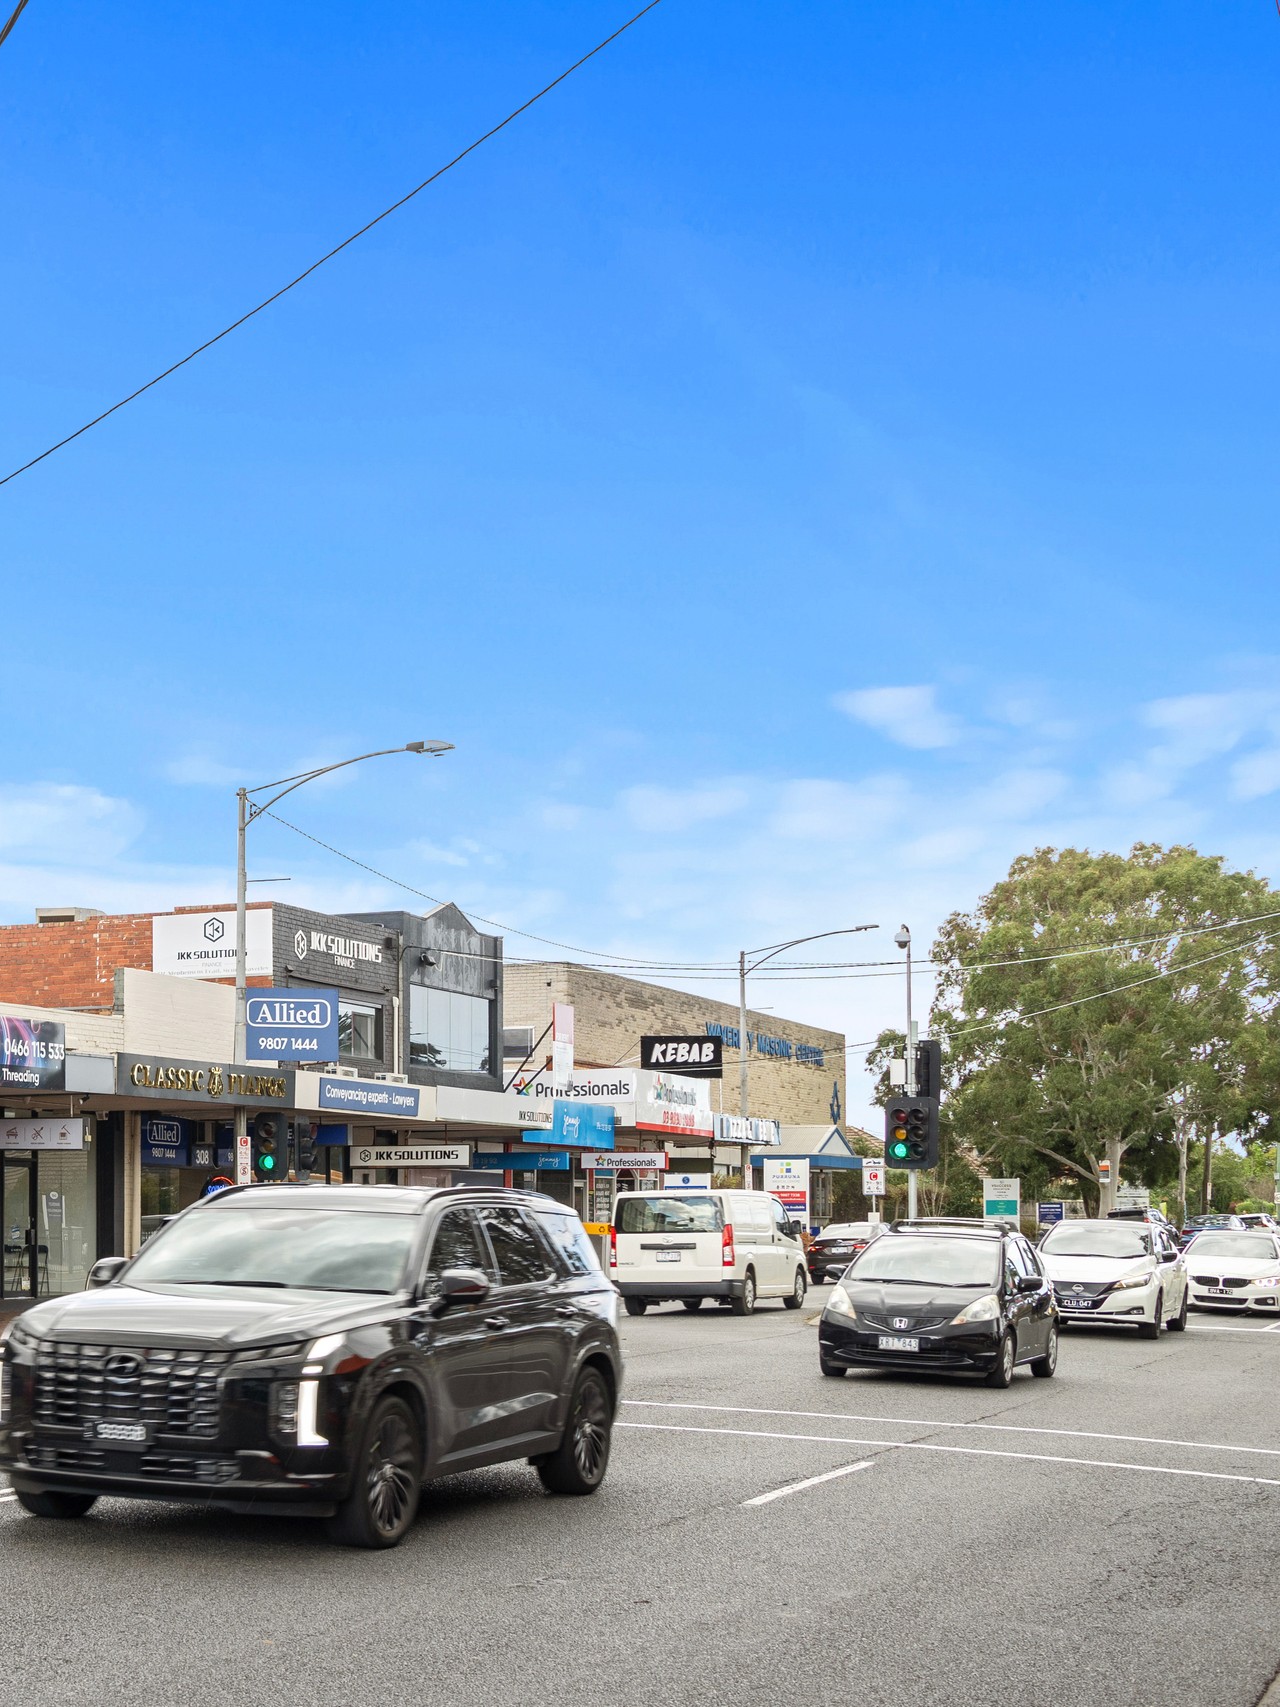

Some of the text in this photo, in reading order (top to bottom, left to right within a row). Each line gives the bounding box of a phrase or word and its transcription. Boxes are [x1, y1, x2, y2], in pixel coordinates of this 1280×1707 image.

[177, 950, 193, 961] JKK
[310, 931, 382, 963] JKK SOLUTIONS
[334, 956, 355, 969] FINANCE
[256, 1003, 321, 1024] Allied
[4, 1038, 65, 1060] 0466 115 533
[259, 1038, 318, 1050] 9807 1444
[650, 1042, 715, 1063] KEBAB
[757, 1034, 792, 1060] MASONIC
[2, 1067, 39, 1086] Threading
[131, 1063, 286, 1098] CLASSIC PIANOS
[325, 1085, 415, 1107] Conveyancing experts Lawyers
[151, 1124, 177, 1142] Allied
[152, 1148, 176, 1159] 9807 1444
[196, 1150, 210, 1164] 308
[374, 1149, 459, 1161] JKK SOLUTIONS
[607, 1158, 657, 1167] Professionals
[879, 1337, 918, 1349] XRT 843
